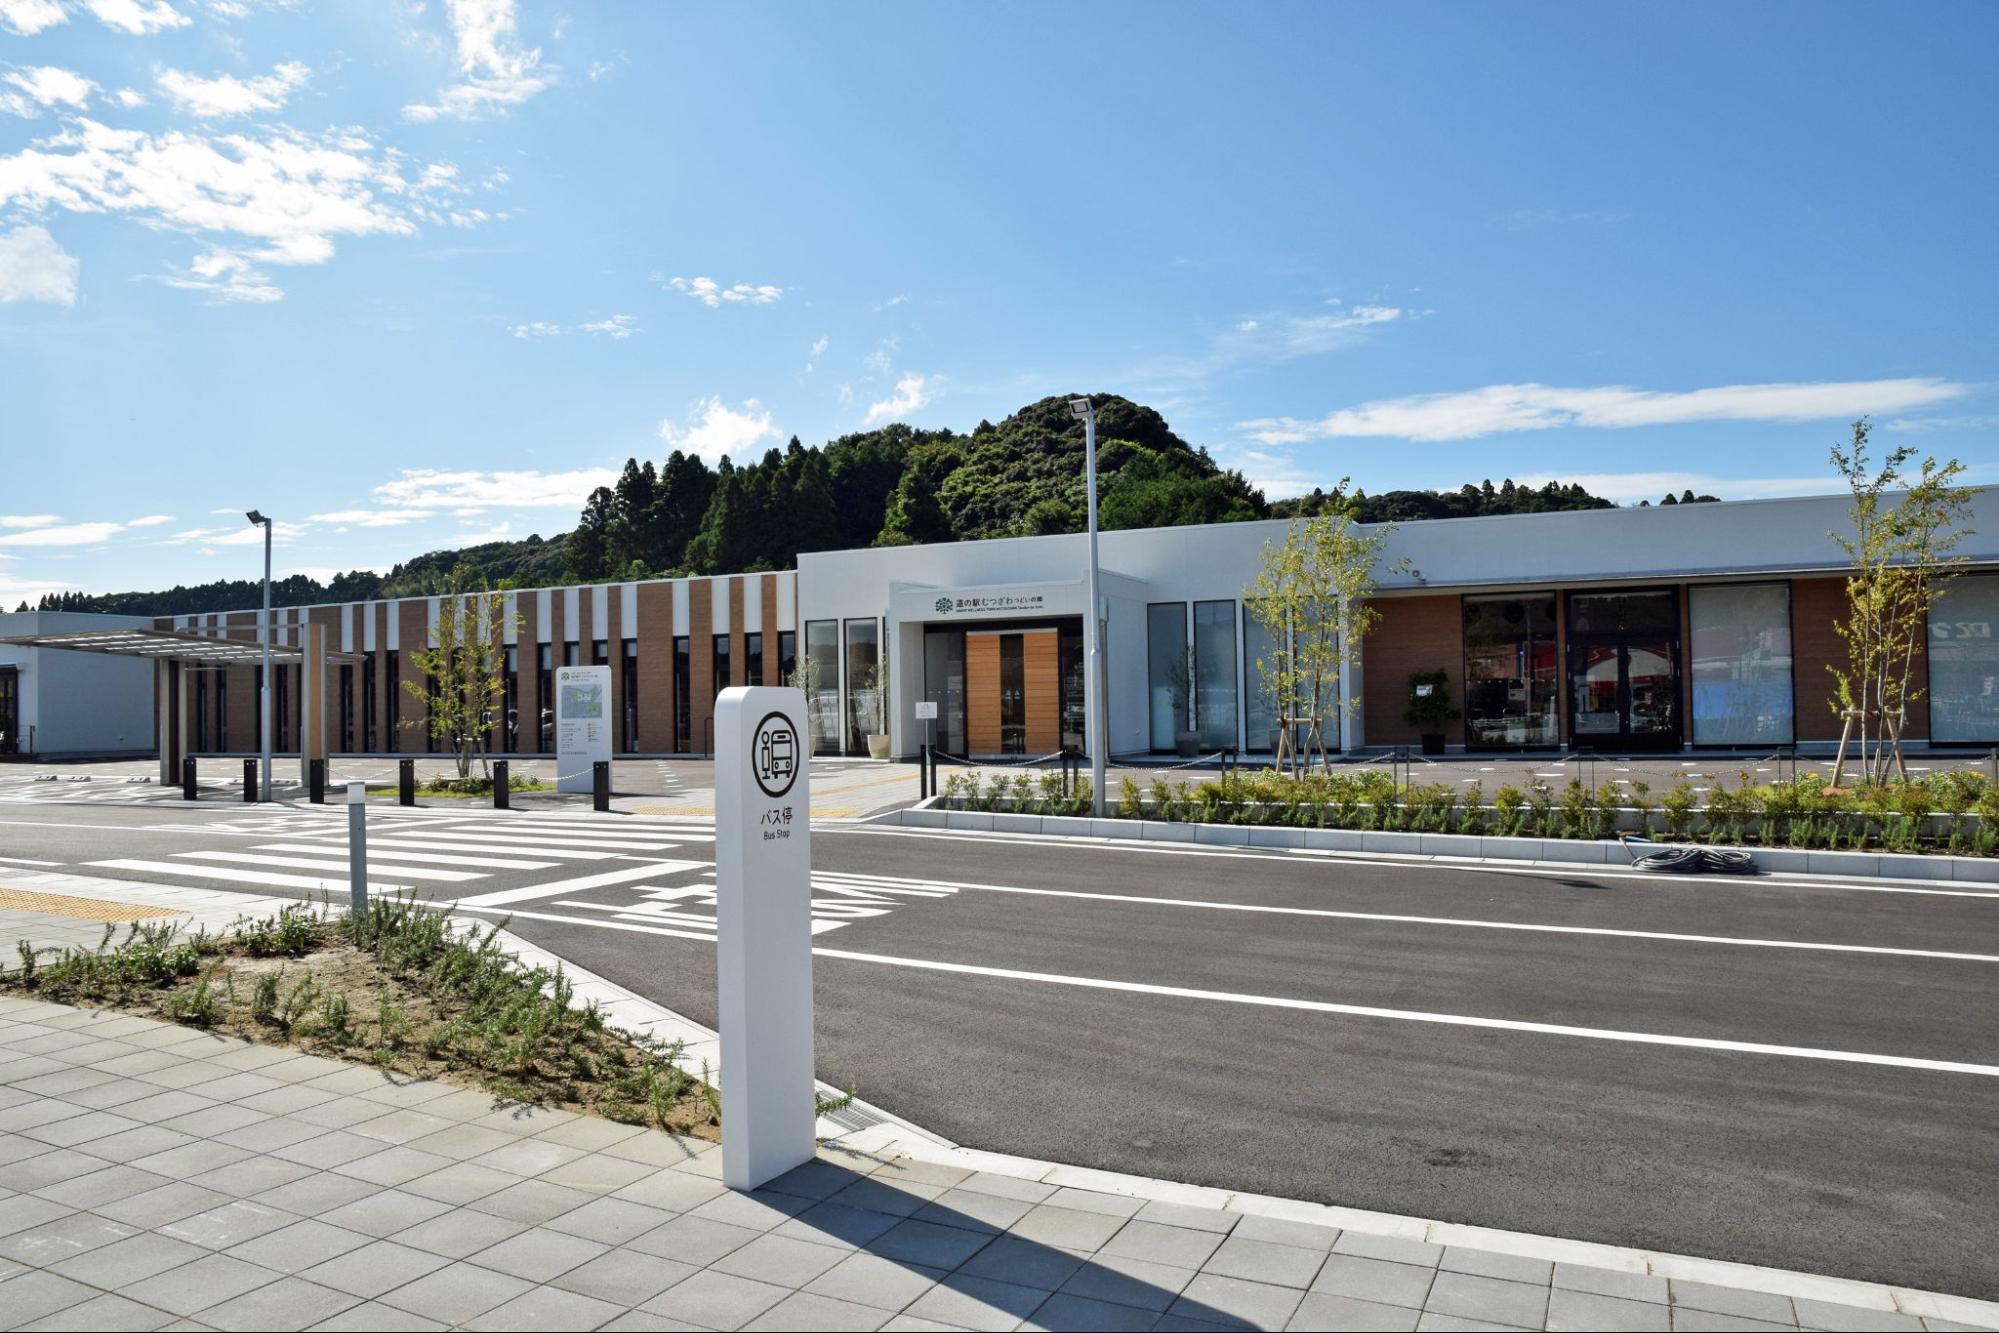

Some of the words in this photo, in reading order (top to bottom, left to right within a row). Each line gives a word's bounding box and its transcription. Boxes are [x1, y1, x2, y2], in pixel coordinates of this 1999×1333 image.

[761, 806, 792, 825] バス停
[764, 831, 775, 840] Bus
[777, 829, 790, 839] Stop
